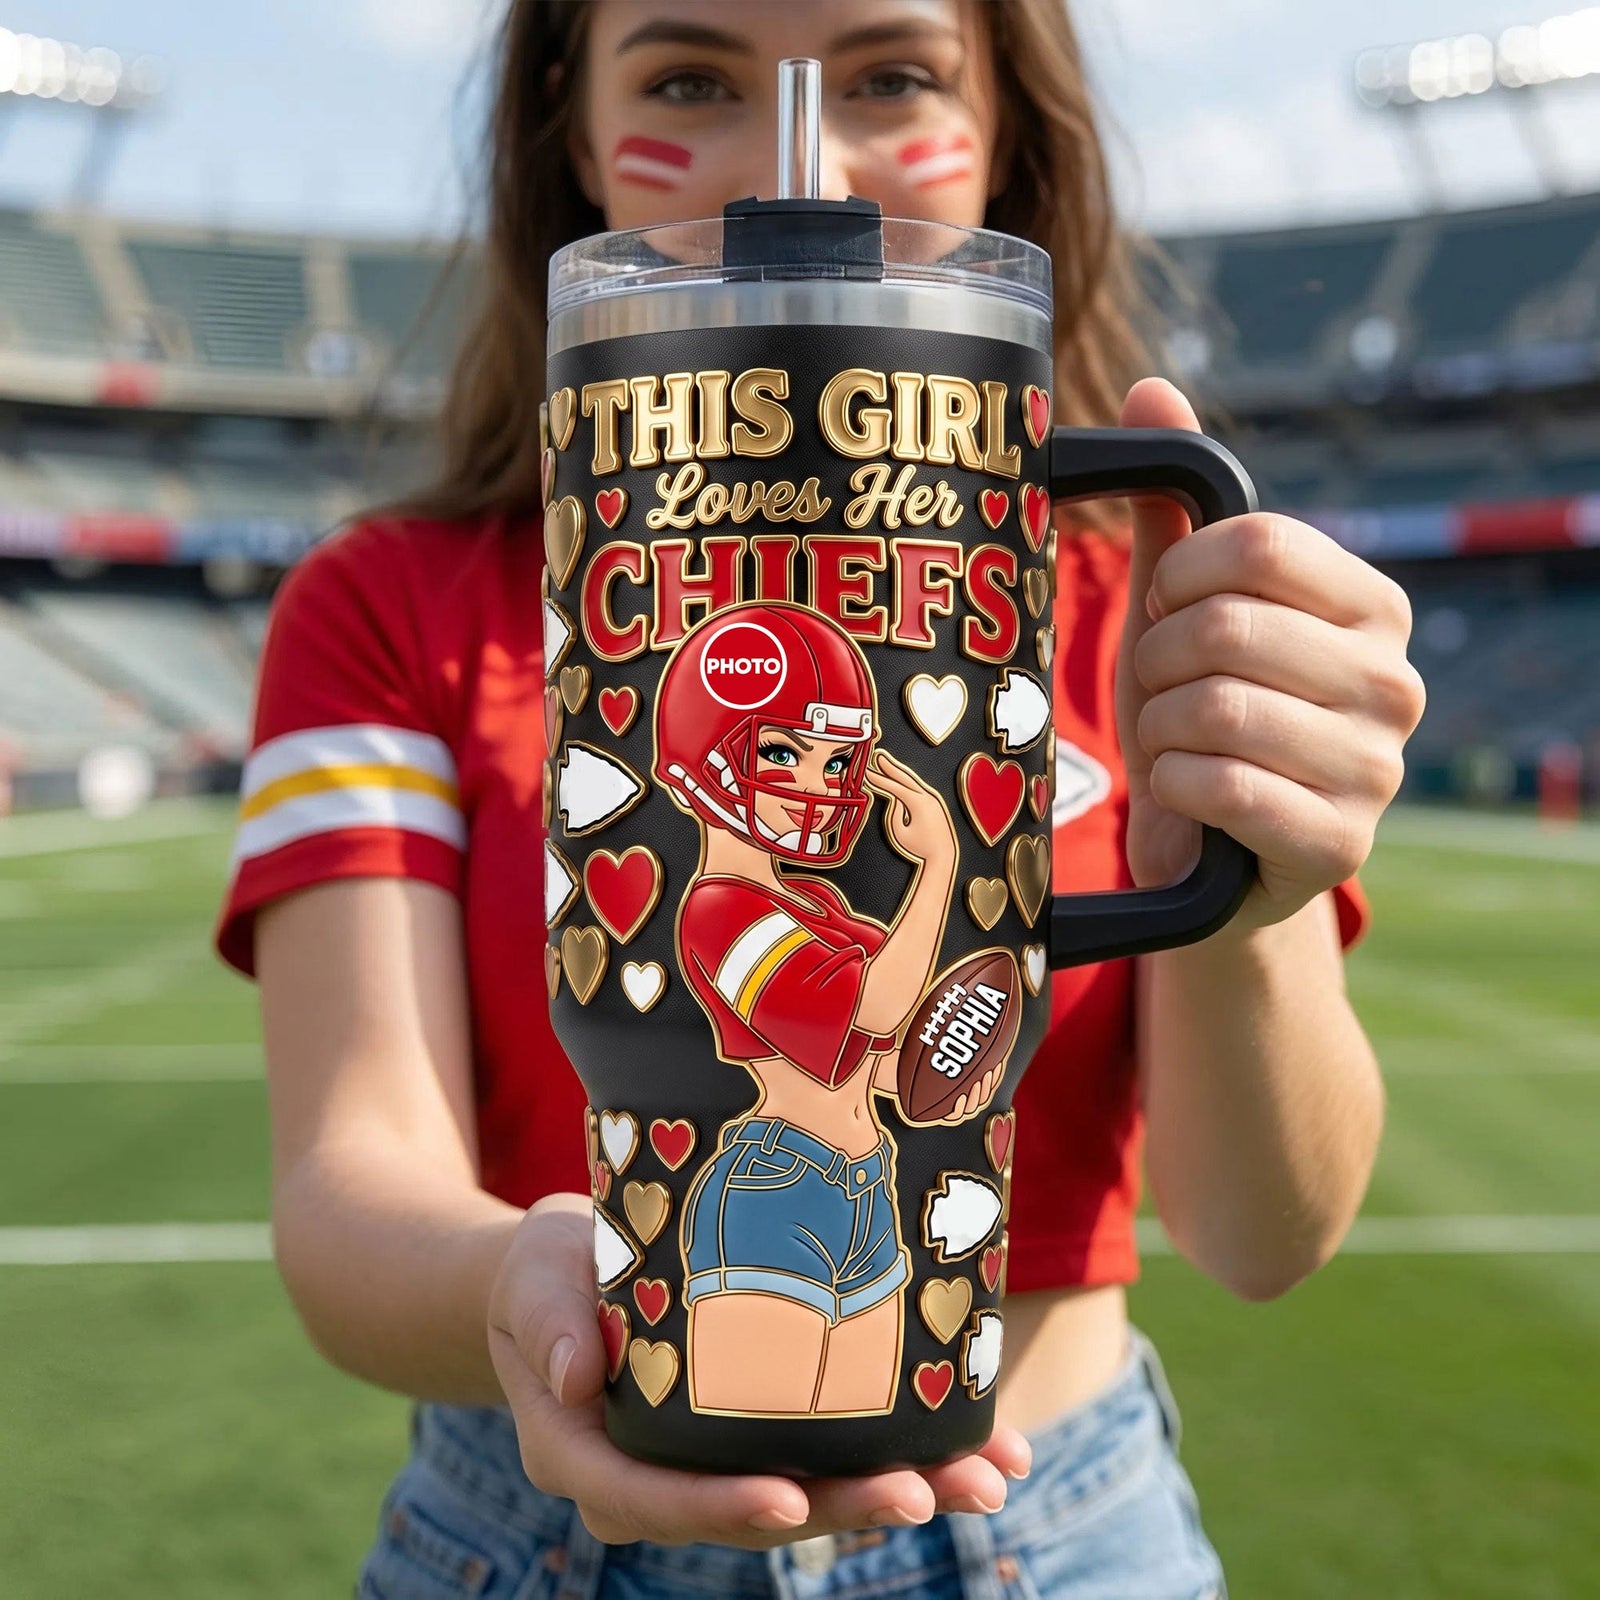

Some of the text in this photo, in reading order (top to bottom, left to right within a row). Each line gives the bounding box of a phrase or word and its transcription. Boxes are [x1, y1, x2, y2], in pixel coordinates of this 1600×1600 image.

[581, 368, 1022, 479] THIS GIRL
[646, 462, 963, 531] Loves Her
[581, 534, 1021, 665] CHIEFS
[706, 657, 781, 675] PHOTO
[930, 983, 1008, 1079] SOPHIA
